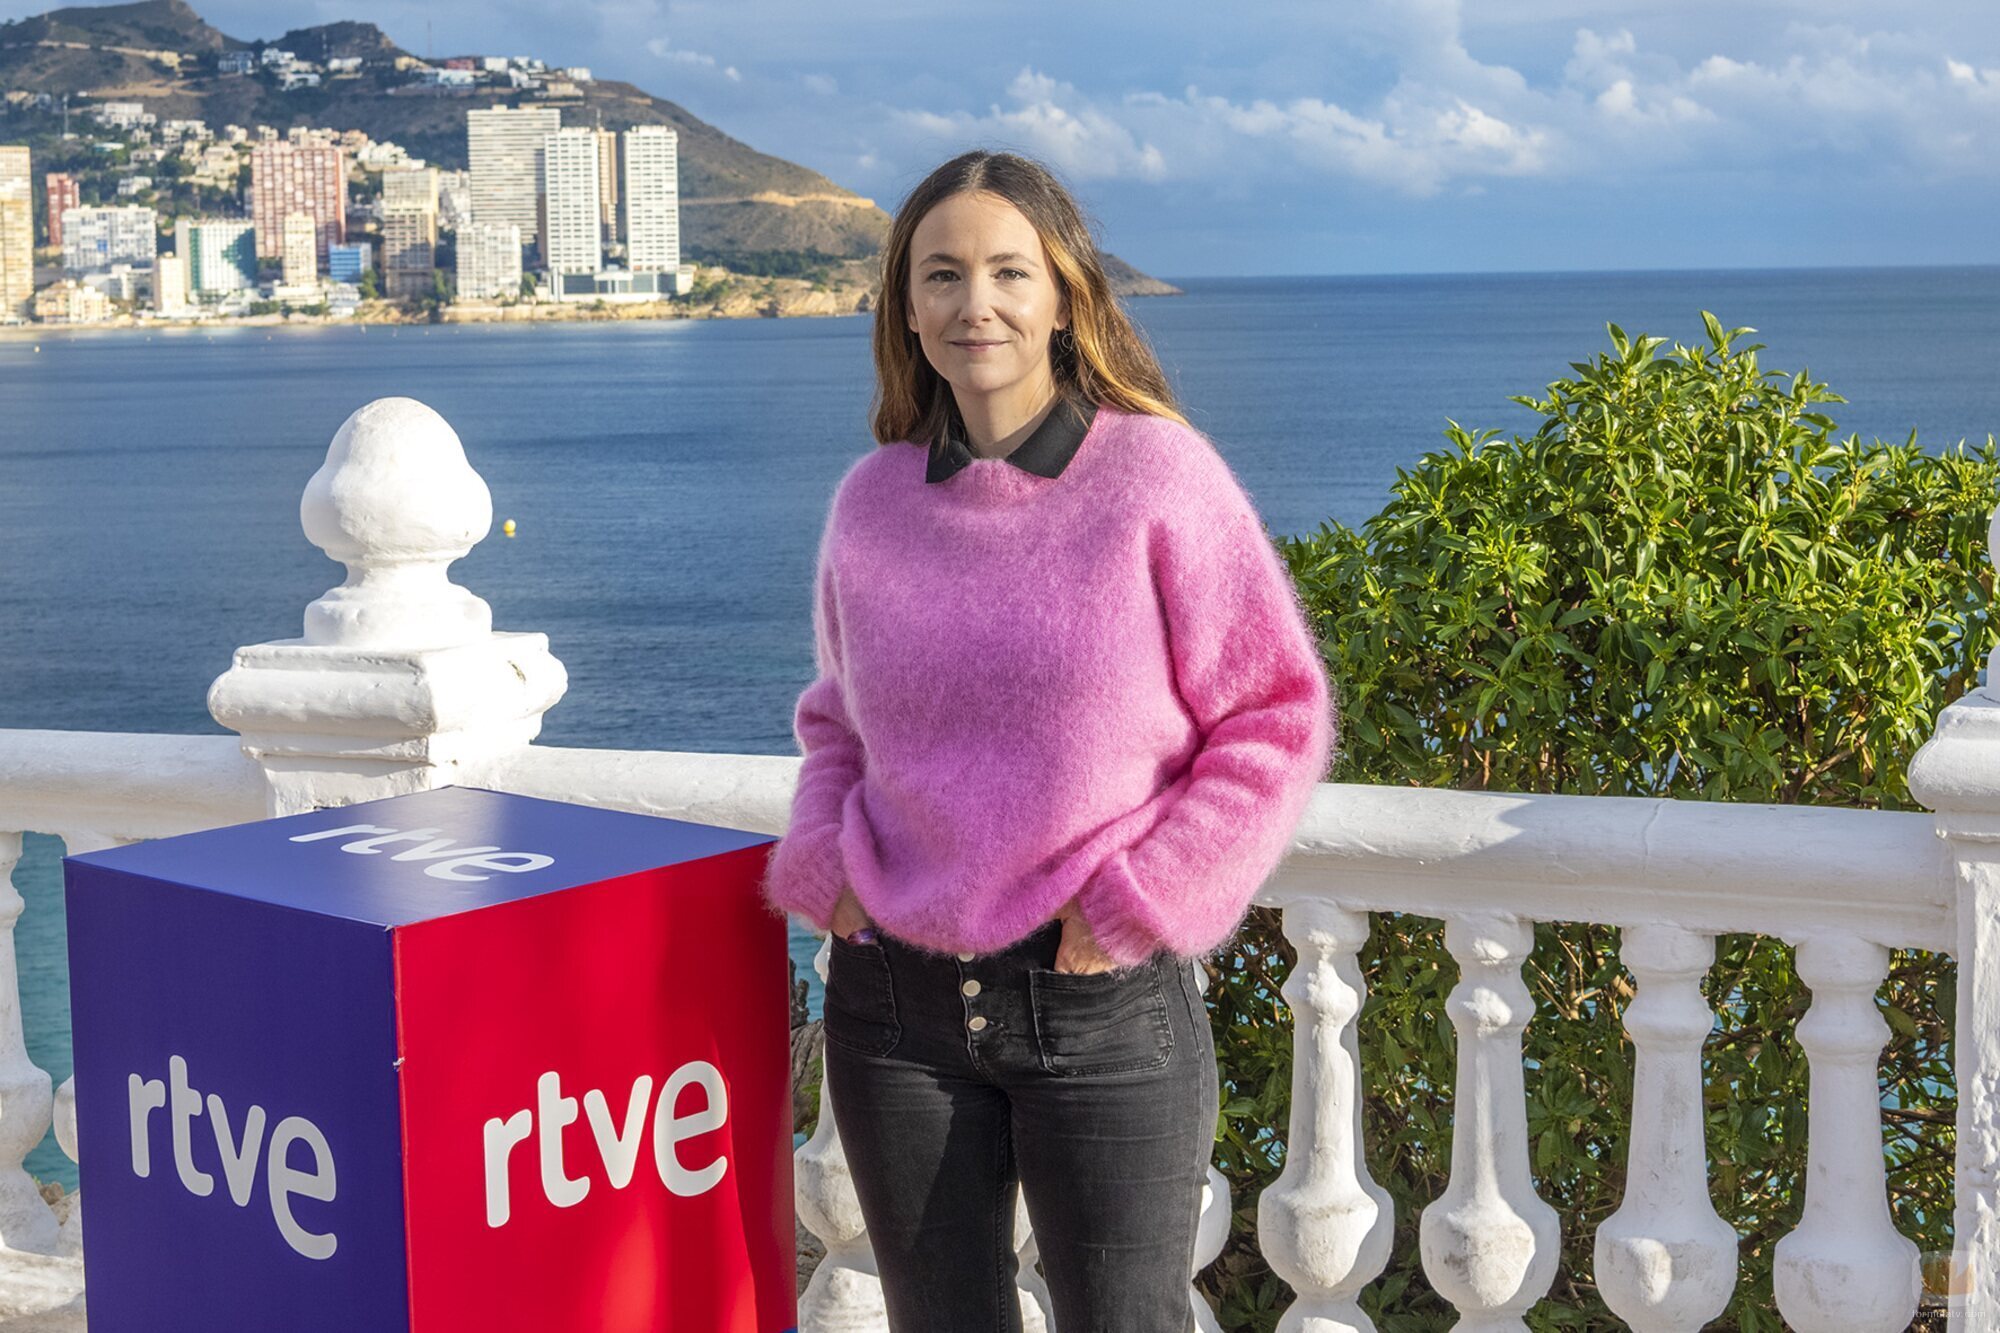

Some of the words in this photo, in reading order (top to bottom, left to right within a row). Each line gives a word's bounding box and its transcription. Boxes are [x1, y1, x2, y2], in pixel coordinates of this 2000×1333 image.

[288, 824, 555, 882] rtve
[128, 1054, 338, 1260] rtve
[483, 1060, 728, 1228] rtve
